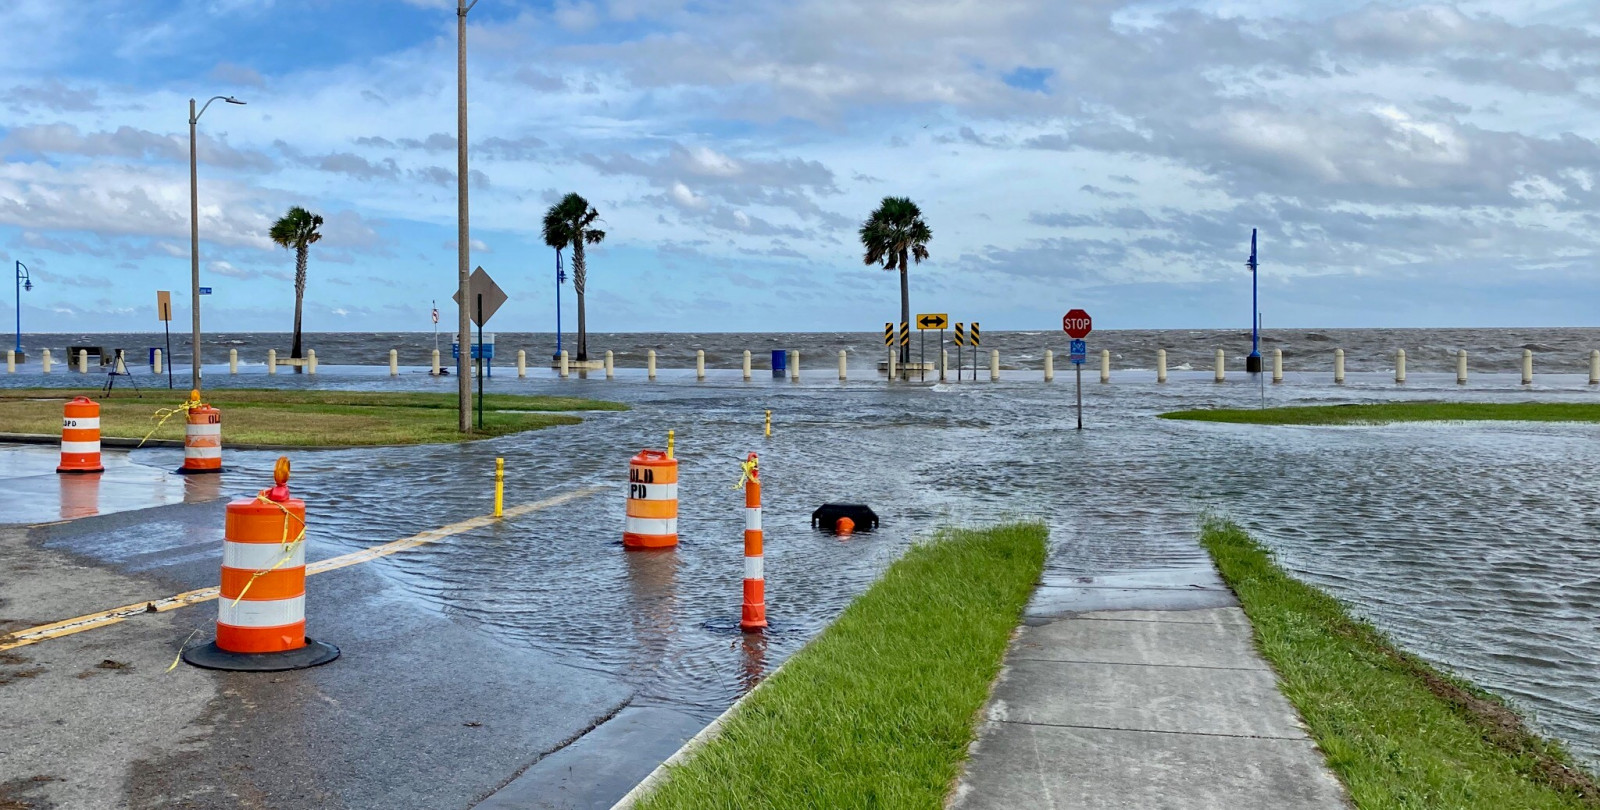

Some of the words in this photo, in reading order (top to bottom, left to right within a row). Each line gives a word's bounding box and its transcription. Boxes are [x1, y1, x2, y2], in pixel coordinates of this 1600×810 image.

[1064, 318, 1090, 330] STOP
[208, 414, 220, 424] OL
[630, 468, 654, 484] OLD
[630, 484, 647, 499] PD
